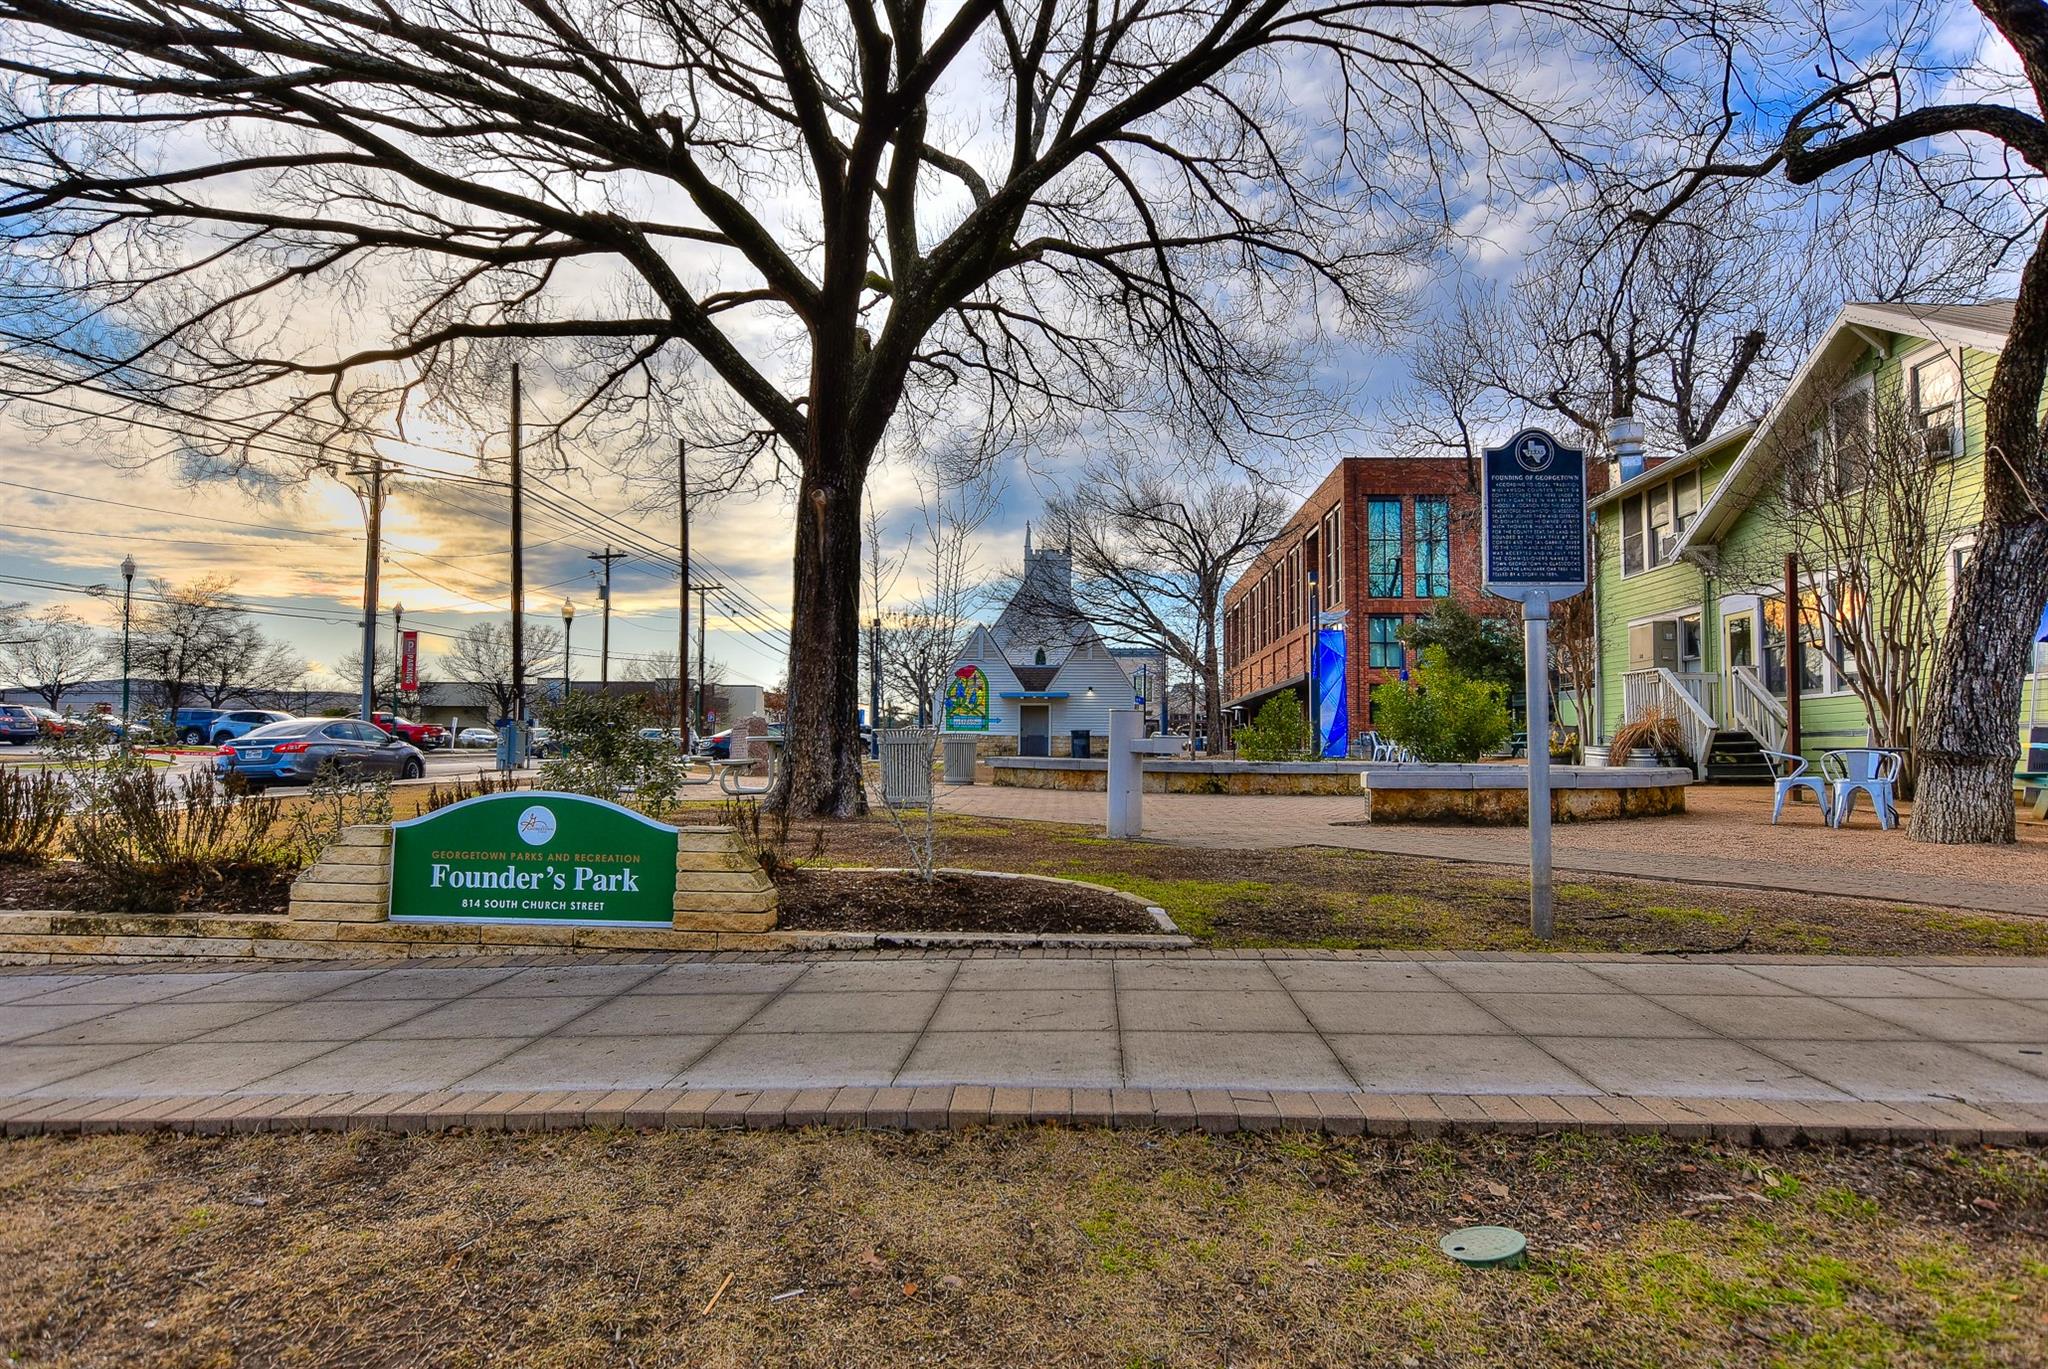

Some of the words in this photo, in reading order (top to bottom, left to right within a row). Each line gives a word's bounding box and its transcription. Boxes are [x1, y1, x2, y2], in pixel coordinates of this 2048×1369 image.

[407, 640, 414, 652] P
[405, 654, 414, 684] PARKING
[432, 850, 506, 860] GEORGETOWN
[511, 852, 543, 861] PARKS
[547, 853, 570, 862] AND
[574, 854, 640, 863] RECREATION
[430, 864, 566, 891] Founder's
[573, 866, 640, 892] Park
[462, 899, 480, 908] 814
[484, 899, 518, 909] SOUTH
[522, 900, 566, 910] CHURCH
[570, 902, 605, 911] STREET
